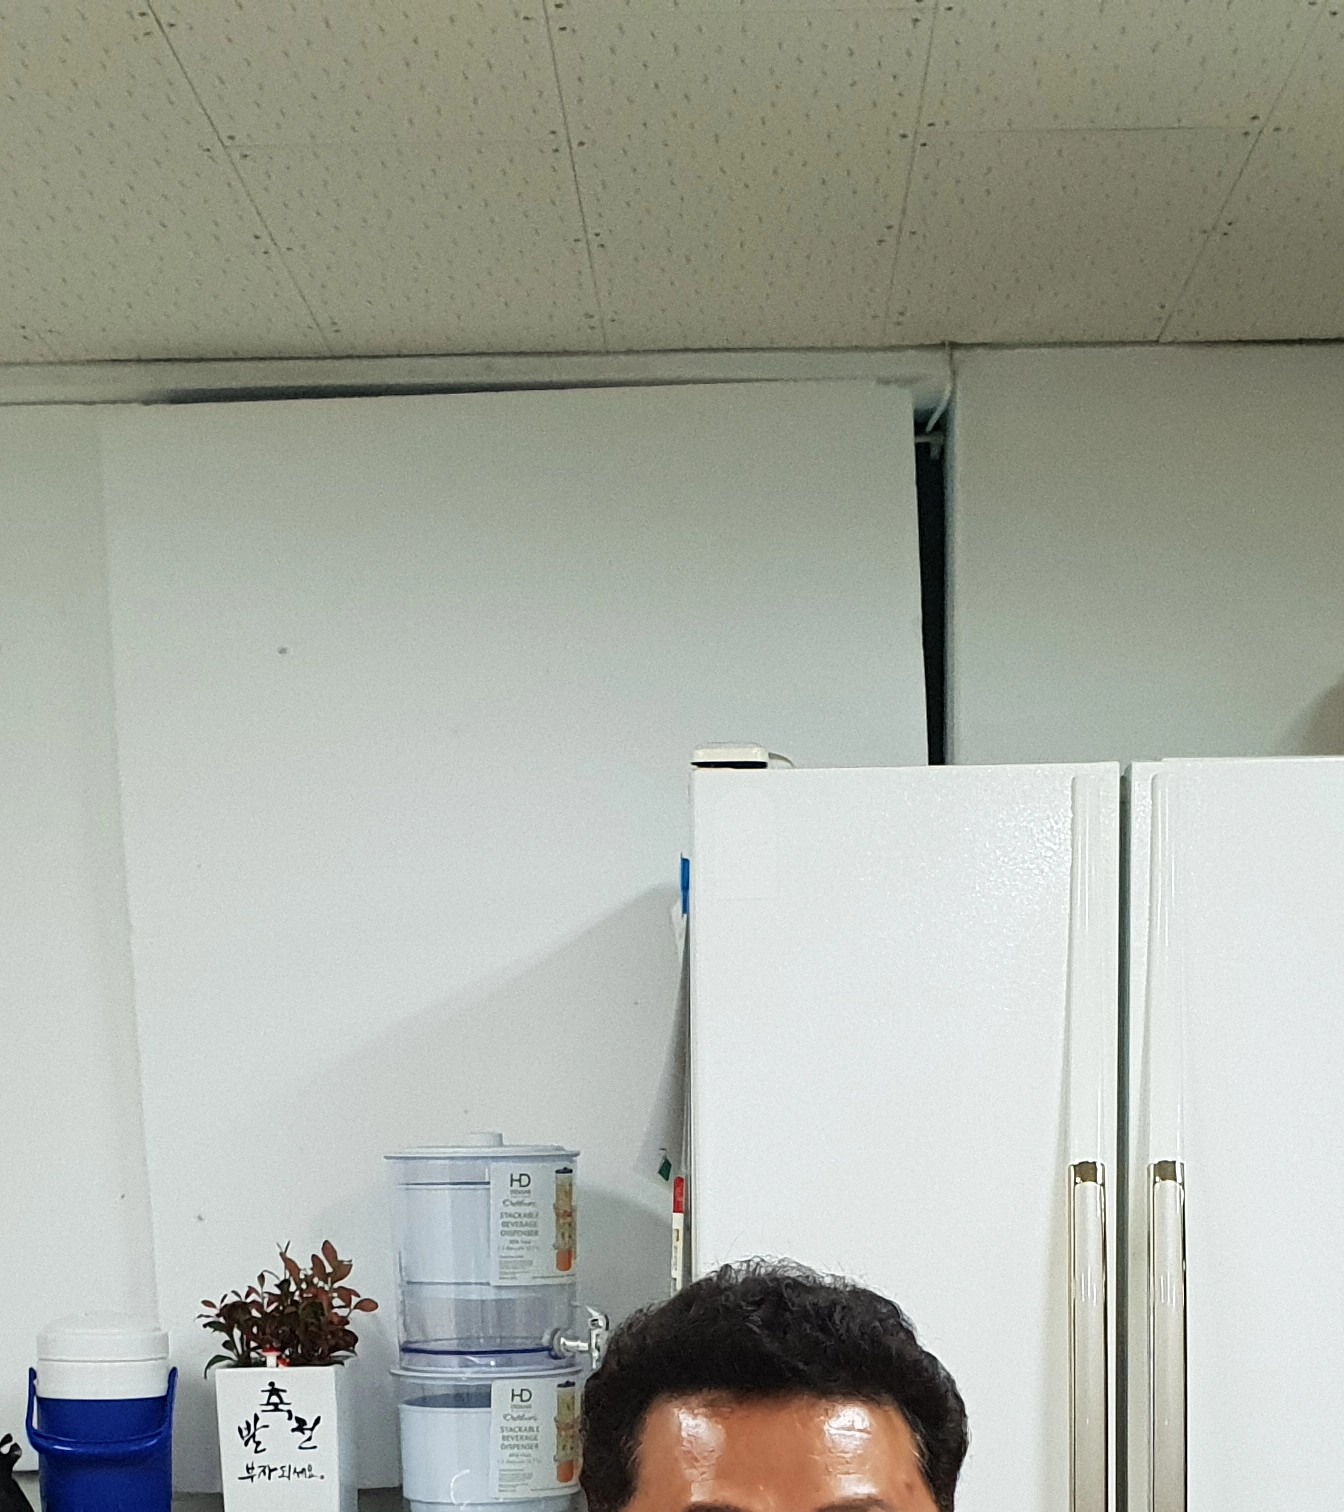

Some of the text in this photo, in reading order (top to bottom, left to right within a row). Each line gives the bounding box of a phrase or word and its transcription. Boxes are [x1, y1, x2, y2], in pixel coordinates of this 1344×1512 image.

[510, 1173, 531, 1188] HD
[259, 1381, 294, 1421] 축
[511, 1388, 532, 1403] HD
